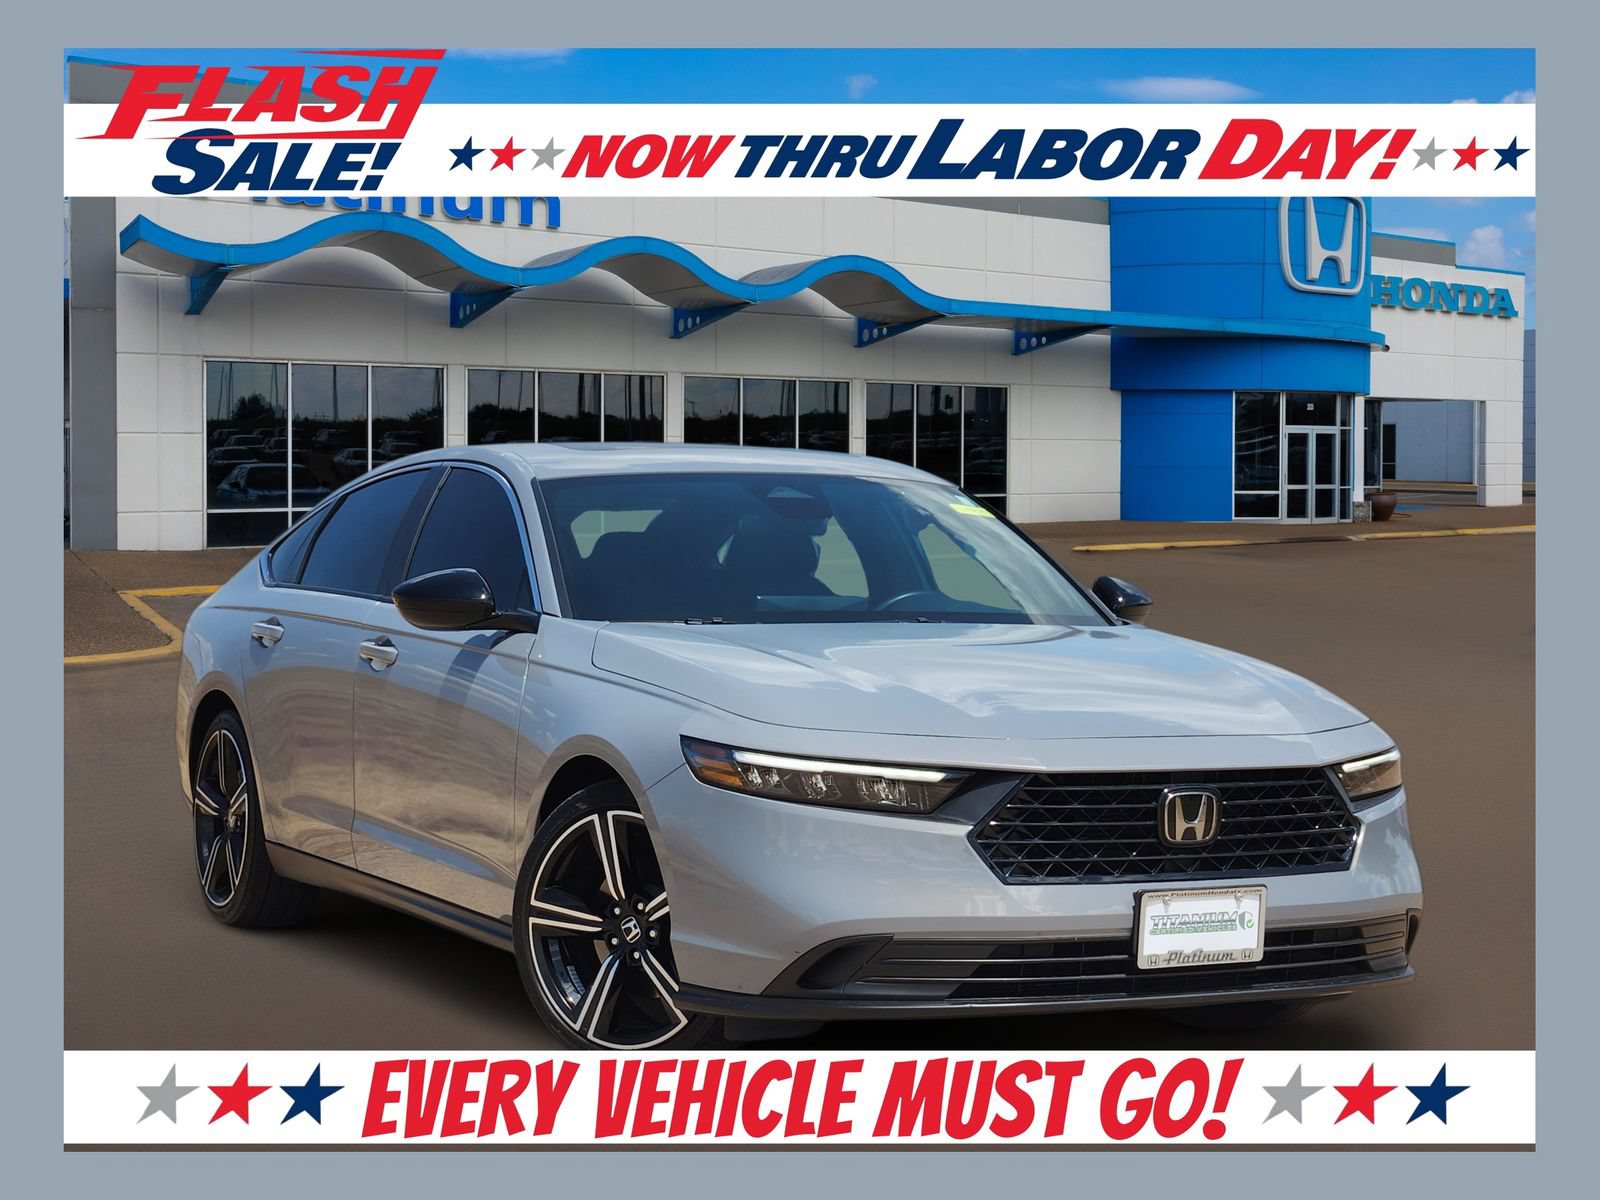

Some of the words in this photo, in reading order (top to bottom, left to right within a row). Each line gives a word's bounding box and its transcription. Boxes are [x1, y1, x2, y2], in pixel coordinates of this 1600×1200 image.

[1371, 275, 1518, 318] HONDA
[1150, 911, 1239, 929] TITANIUM
[1197, 923, 1238, 933] VEHICLES
[1162, 948, 1237, 966] Platinum
